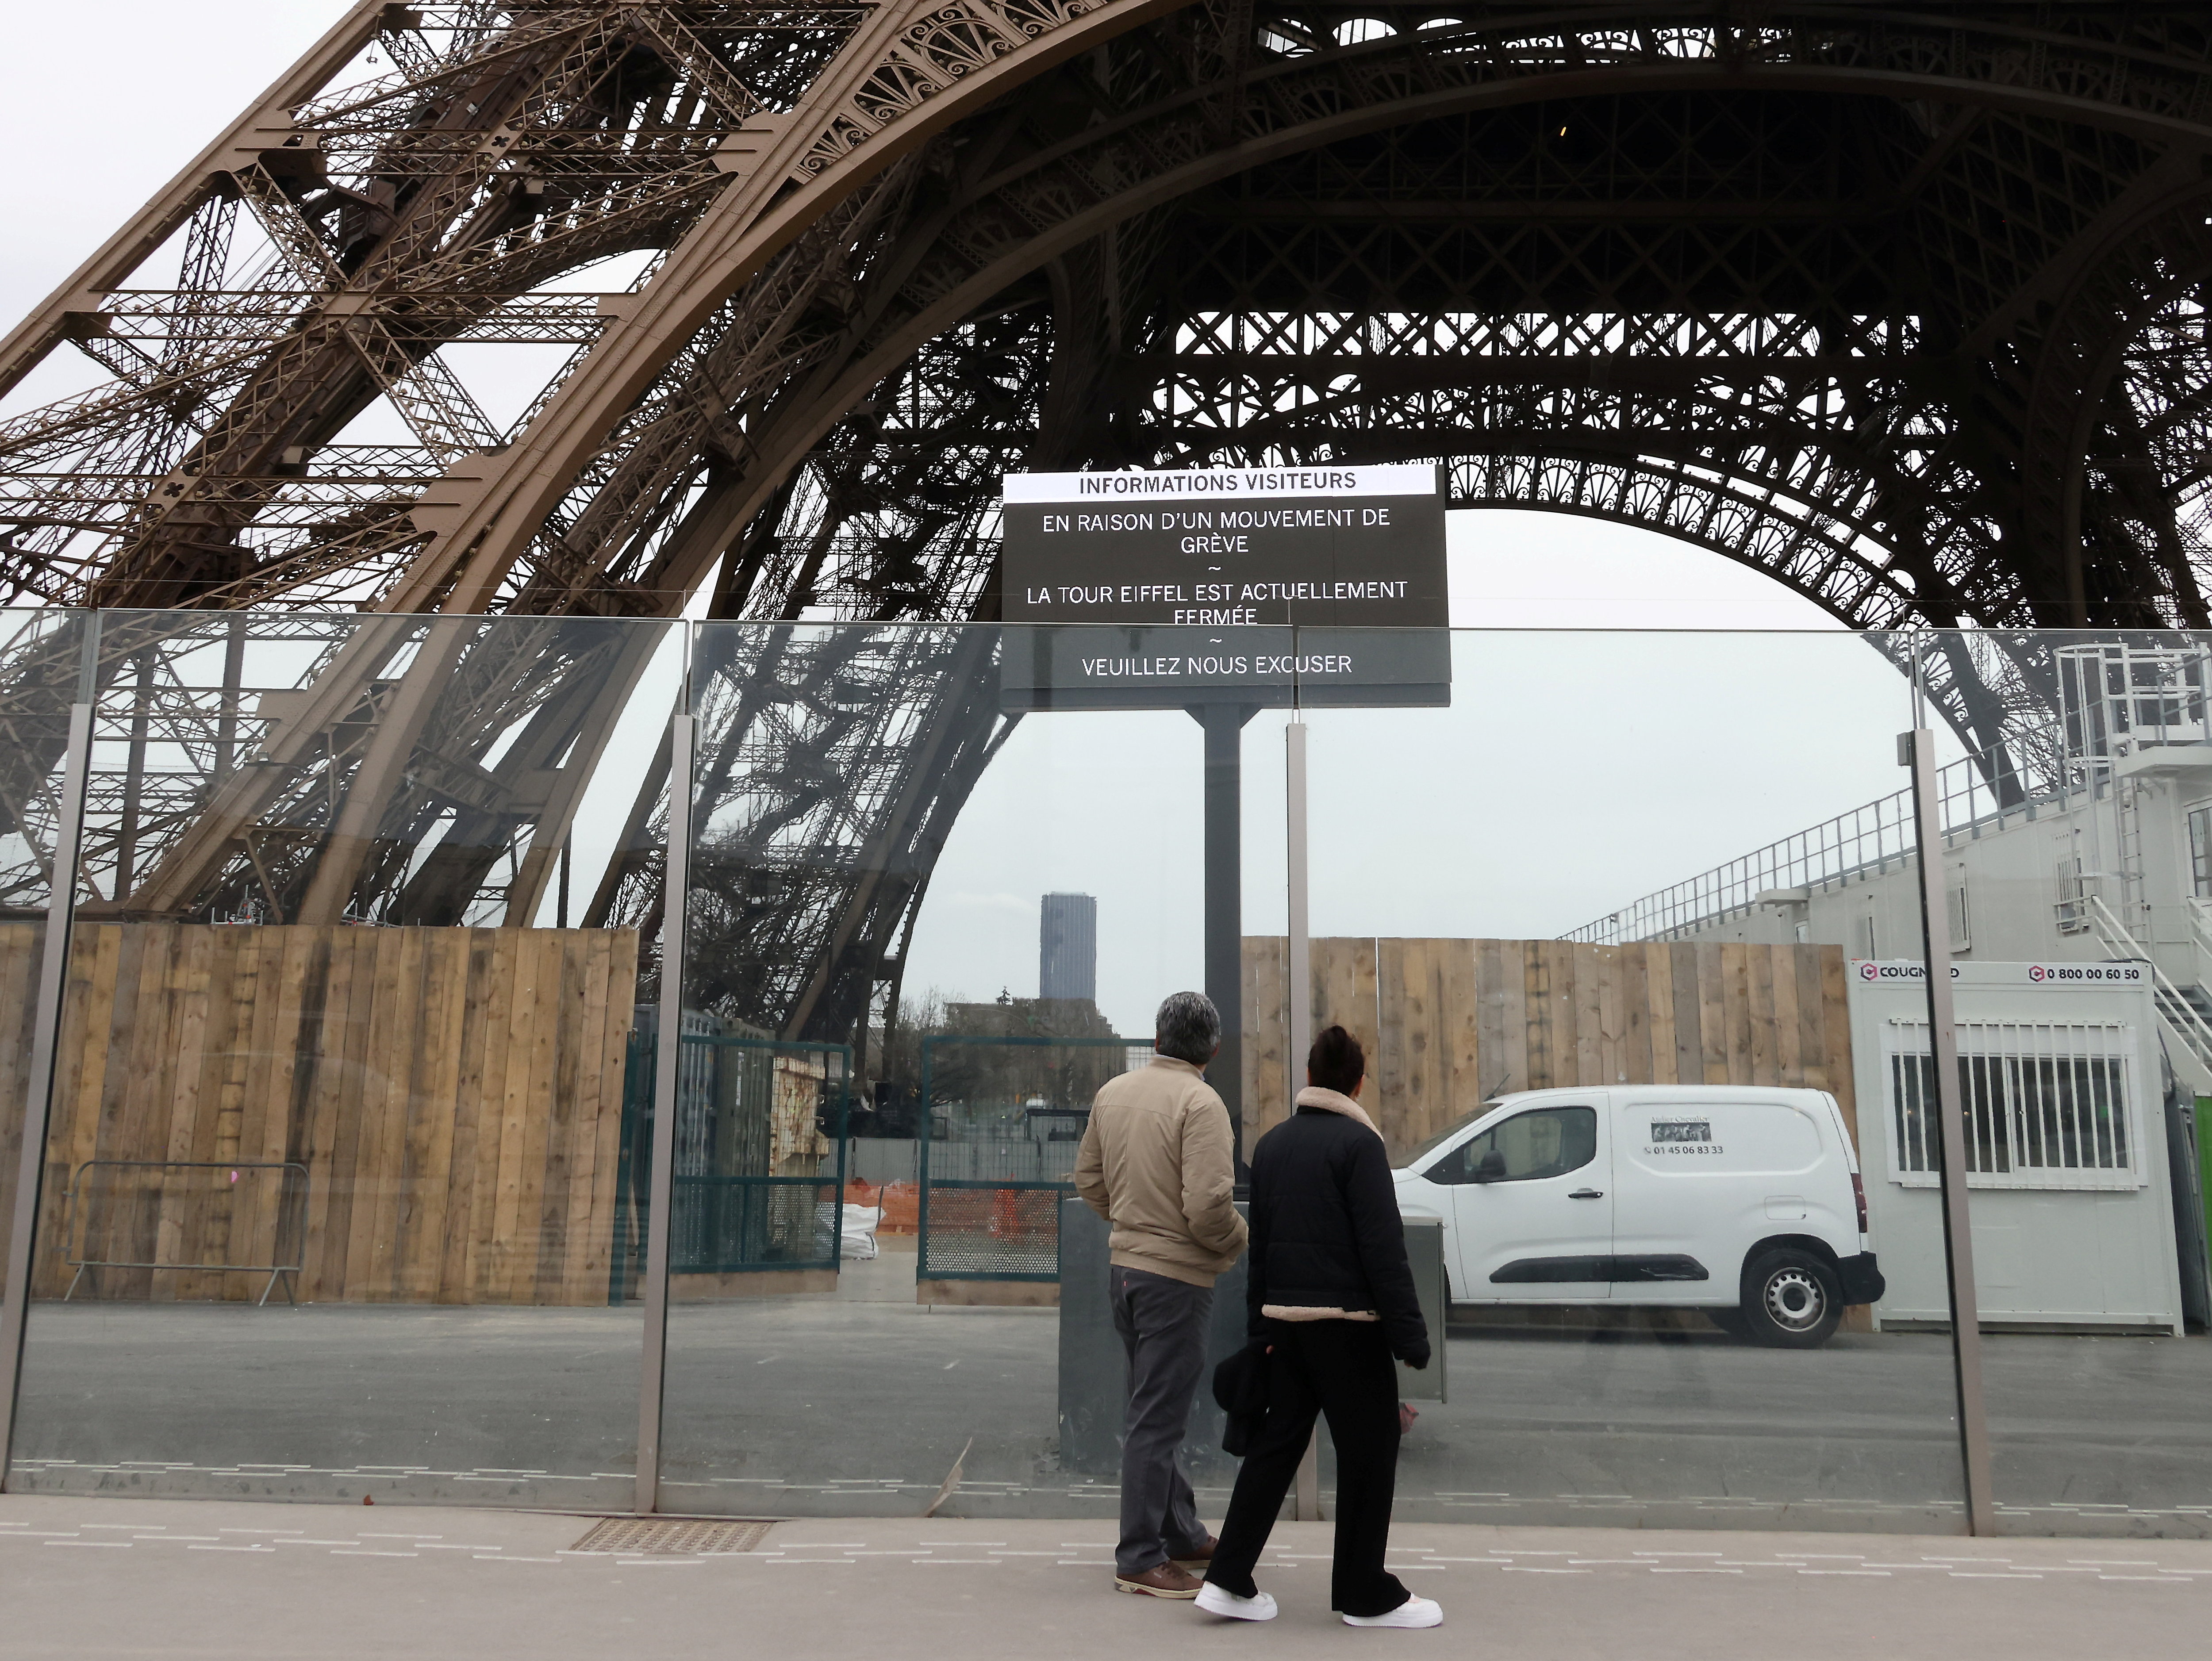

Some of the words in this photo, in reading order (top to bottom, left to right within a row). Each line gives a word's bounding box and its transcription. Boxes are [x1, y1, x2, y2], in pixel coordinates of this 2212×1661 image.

[1080, 474, 1237, 494] INFORMATIONS
[1245, 472, 1356, 490] VISITEURS
[1043, 515, 1069, 532] EN
[1078, 513, 1152, 531] RAISON
[1162, 511, 1211, 530] D’UN
[1220, 509, 1355, 529] MOUVEMENT
[1363, 508, 1390, 526] DE
[1181, 532, 1248, 553] GRÈVE
[1027, 587, 1051, 604] LA
[1057, 586, 1113, 603] TOUR
[1121, 585, 1188, 602] EIFFEL
[1196, 584, 1233, 602] EST
[1240, 581, 1408, 600] ACTUELLEMENT
[1175, 604, 1258, 625] FERMÉE
[1081, 657, 1180, 676] VEUILLEZ
[1188, 656, 1247, 675] NOUS
[1256, 655, 1352, 674] EXCUSER
[1880, 967, 1959, 978] COUGND
[2047, 969, 2055, 978] 0
[2059, 969, 2082, 978] 800
[2086, 969, 2102, 979] 00
[2106, 969, 2120, 979] 60
[2125, 969, 2139, 979] 50
